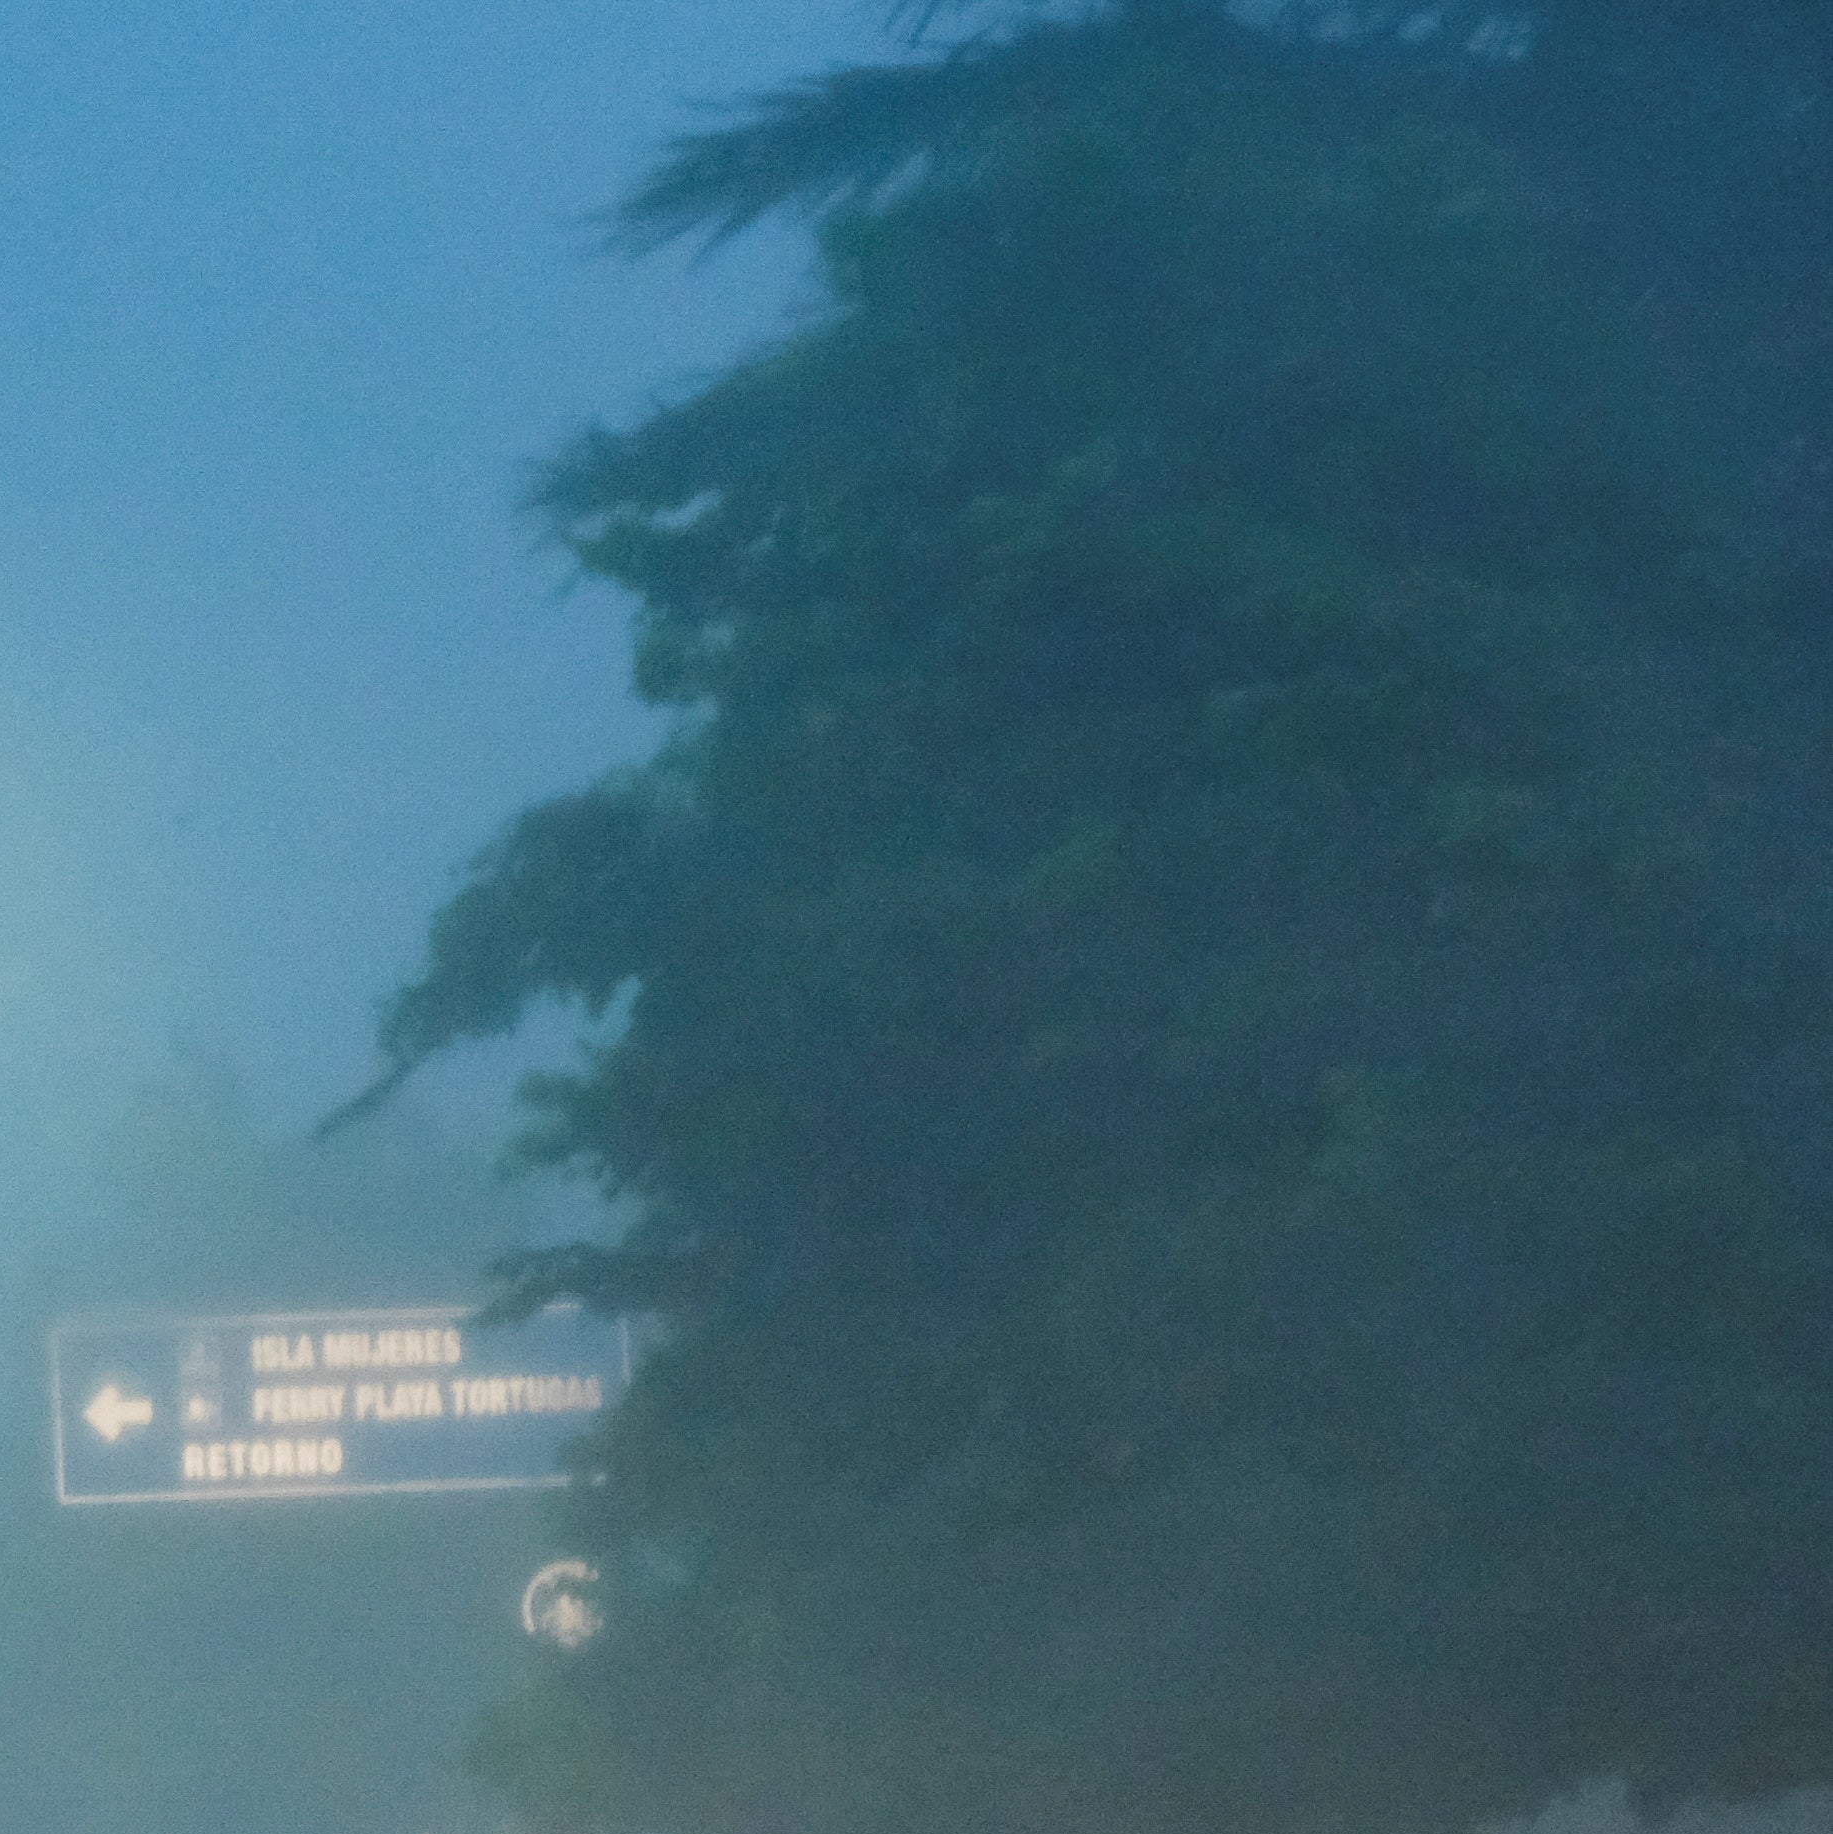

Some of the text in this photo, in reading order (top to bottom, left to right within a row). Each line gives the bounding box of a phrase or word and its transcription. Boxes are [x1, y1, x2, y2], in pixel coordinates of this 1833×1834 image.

[252, 1330, 461, 1371] ISLA MUJERES
[354, 1383, 442, 1420] PLAYA
[183, 1439, 343, 1480] RETORNO
